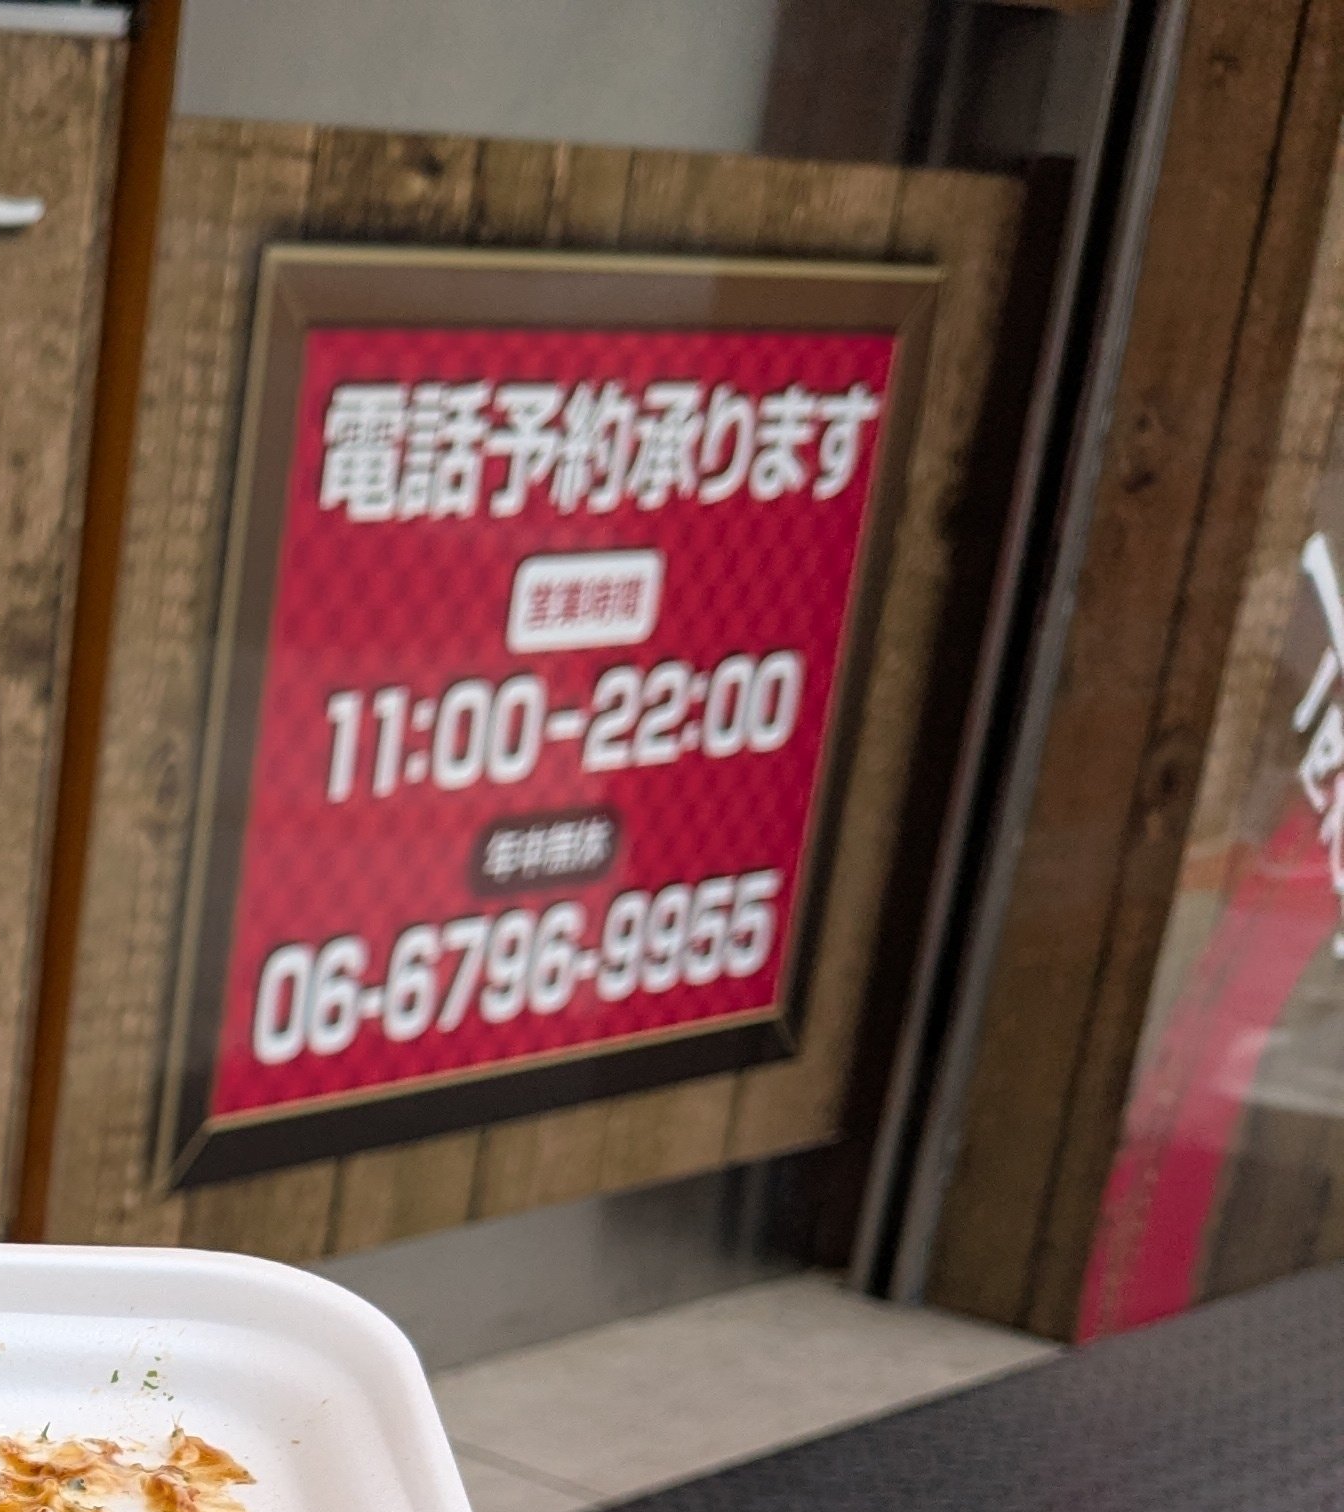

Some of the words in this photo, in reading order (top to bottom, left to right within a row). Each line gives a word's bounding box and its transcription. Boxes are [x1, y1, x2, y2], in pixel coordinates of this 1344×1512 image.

[318, 378, 881, 522] 電話予約承ります
[323, 650, 805, 803] 11:00-22:00
[252, 868, 785, 1066] 06-6796-9955
